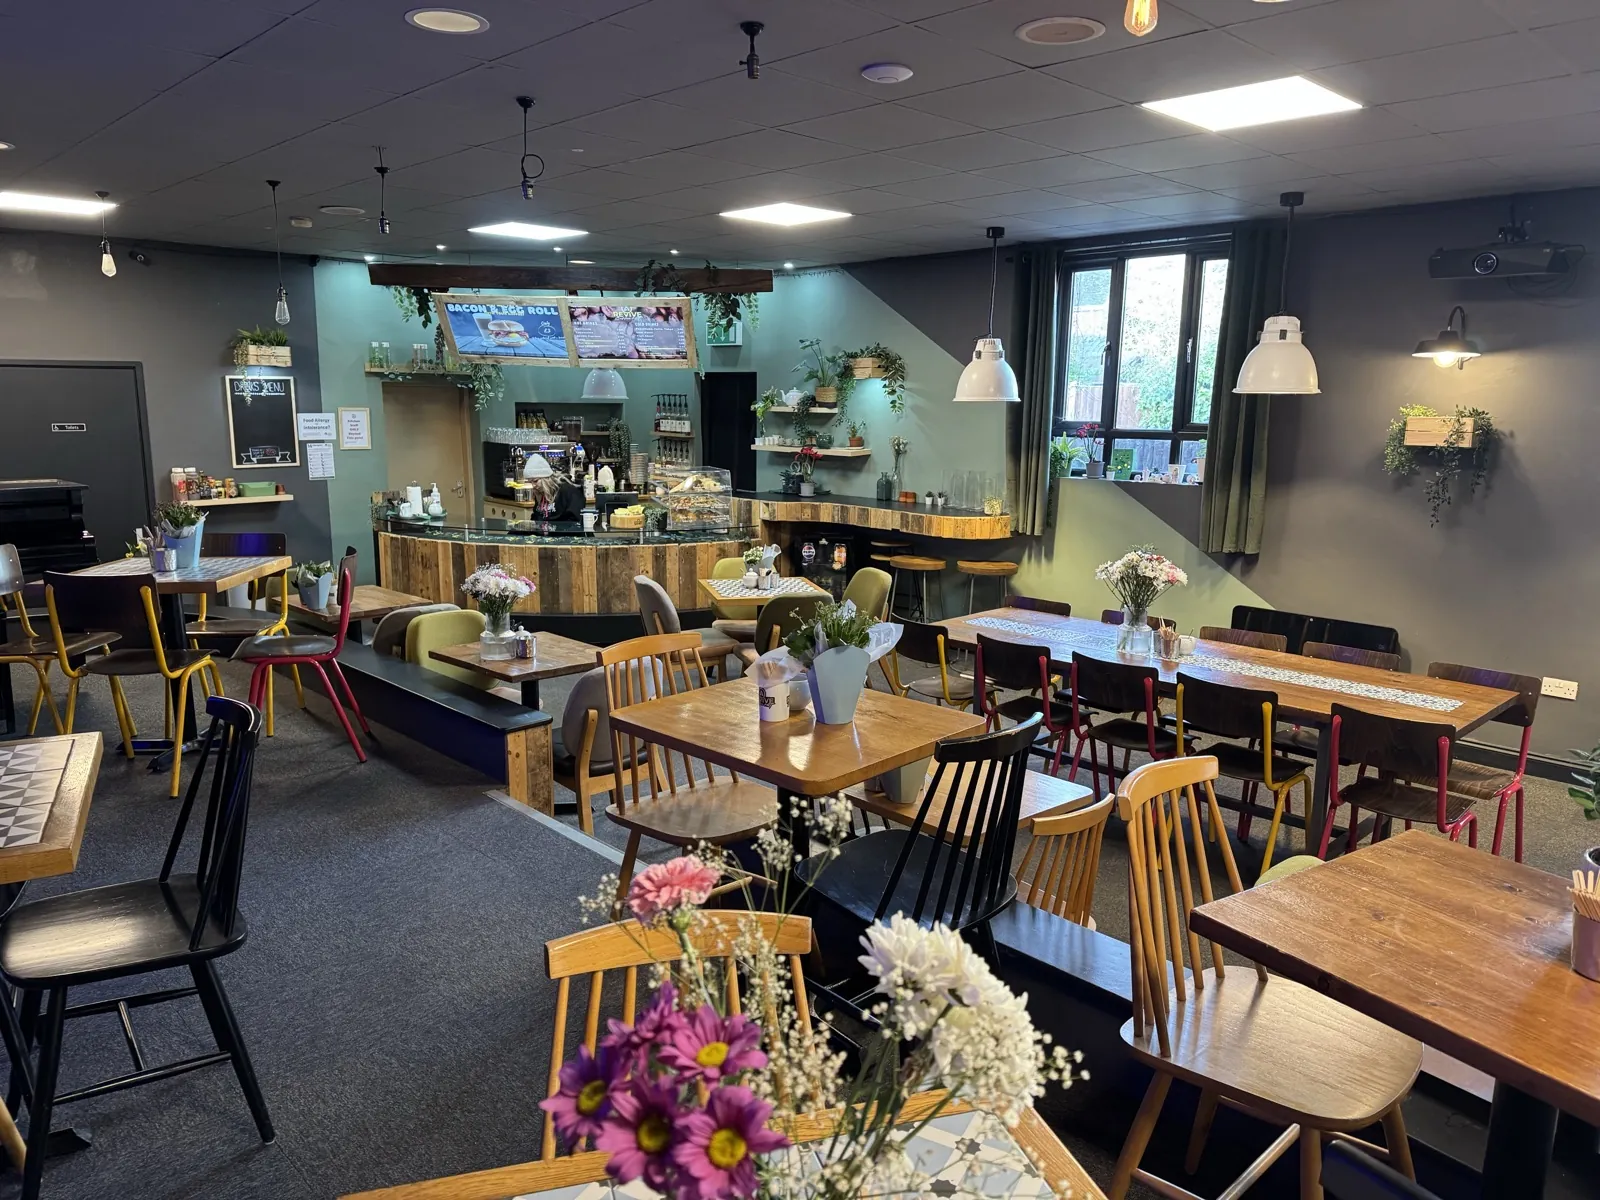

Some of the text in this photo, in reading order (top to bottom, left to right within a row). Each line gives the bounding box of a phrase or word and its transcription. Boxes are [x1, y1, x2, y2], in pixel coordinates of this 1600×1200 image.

[447, 304, 487, 313] BACON
[502, 305, 524, 314] EGG
[527, 306, 559, 316] ROLL
[233, 380, 260, 392] DRKS
